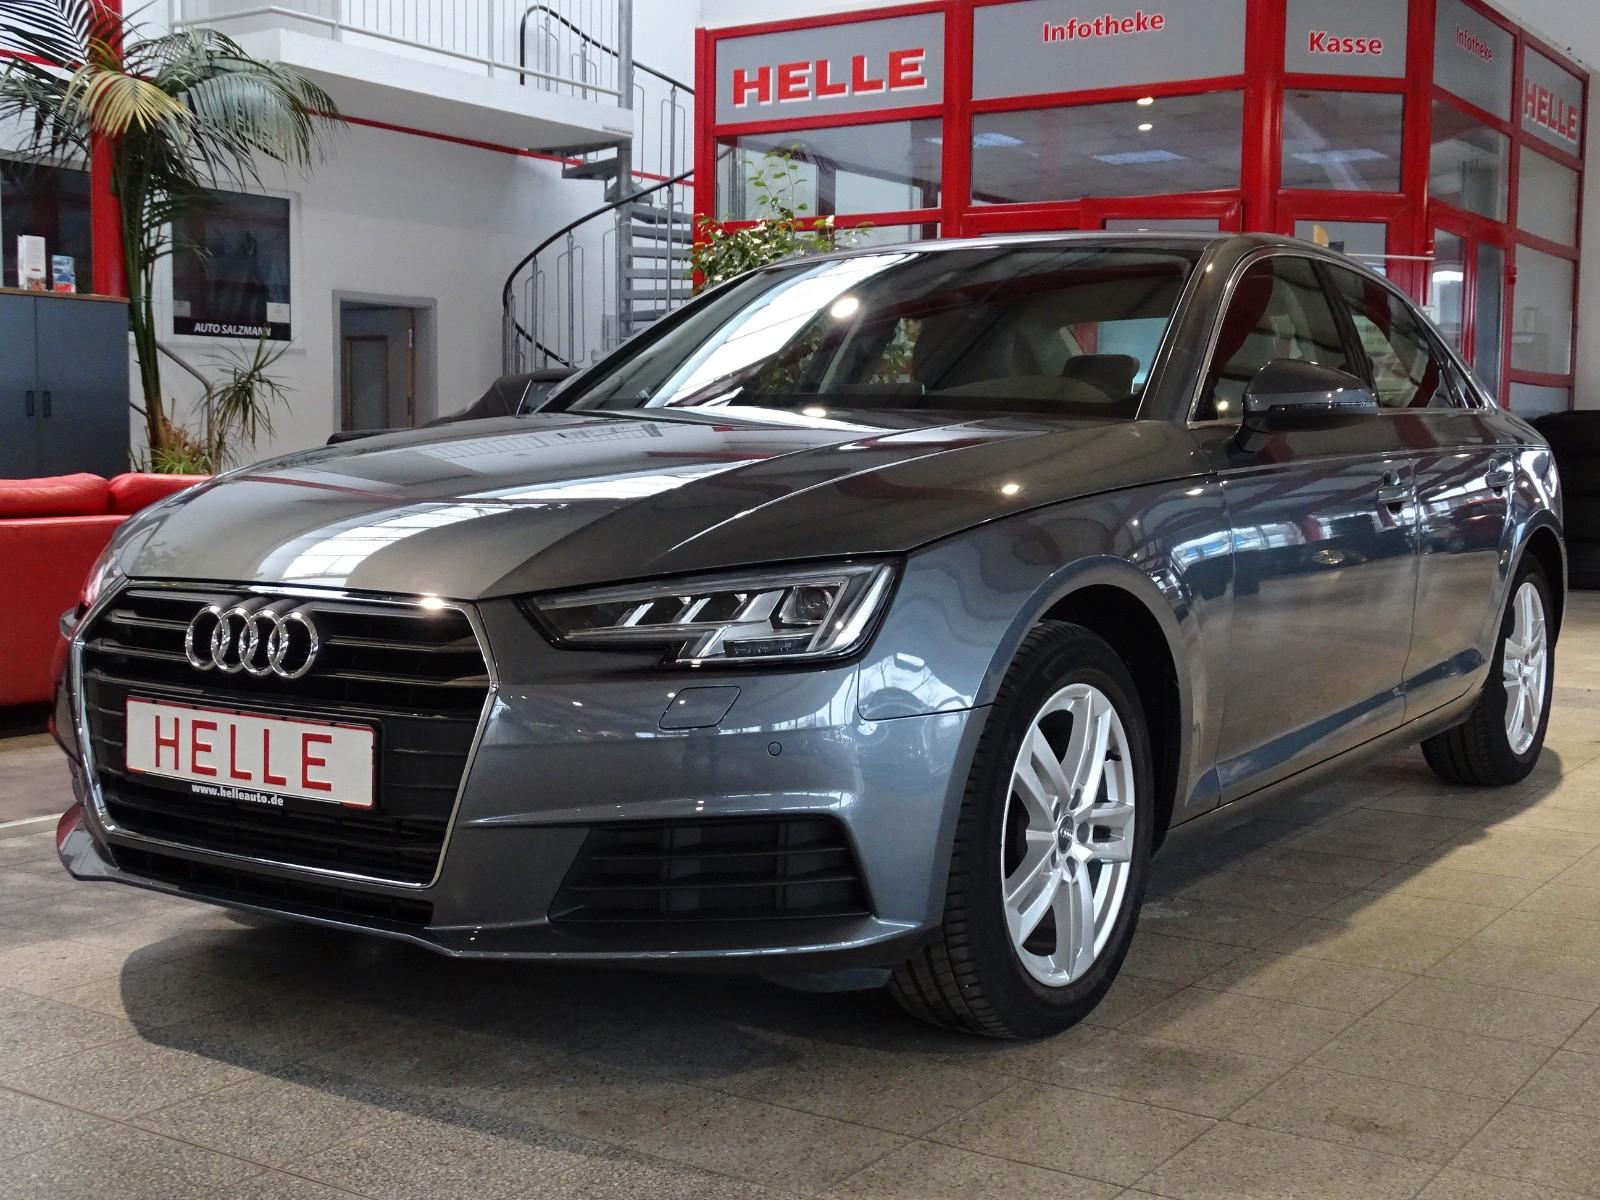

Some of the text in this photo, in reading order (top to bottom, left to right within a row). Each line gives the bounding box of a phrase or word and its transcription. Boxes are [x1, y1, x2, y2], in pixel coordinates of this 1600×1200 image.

[1043, 9, 1166, 43] Infotheke
[1308, 30, 1384, 56] Kasse
[1456, 26, 1493, 63] Infotheke
[733, 48, 927, 108] HELLE
[1523, 78, 1578, 144] HELLE
[193, 322, 220, 334] AUTO
[155, 715, 332, 791] HELLE
[191, 783, 284, 806] www.helleauto.de
